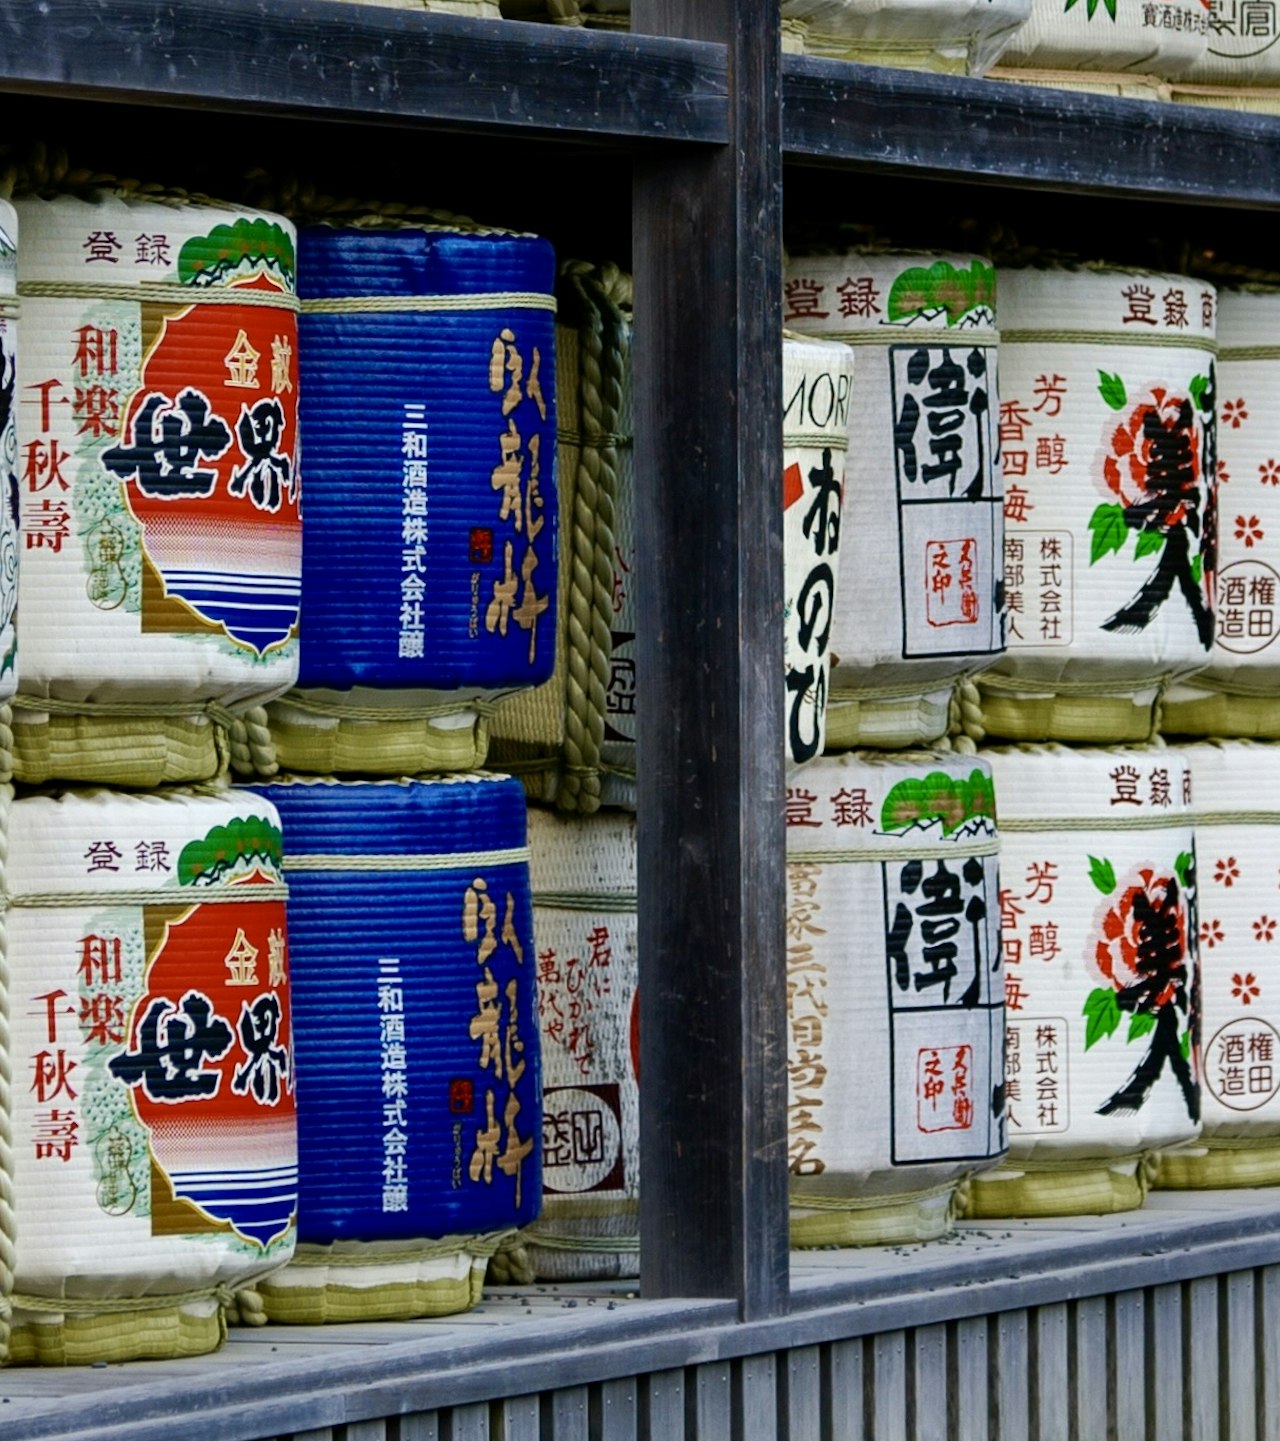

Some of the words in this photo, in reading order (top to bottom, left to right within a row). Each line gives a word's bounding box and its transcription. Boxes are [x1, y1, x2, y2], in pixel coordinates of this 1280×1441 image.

[82, 230, 171, 267] 登録
[784, 277, 881, 321] 登録
[70, 323, 119, 438] 和楽
[1033, 374, 1068, 476] 芳醇
[20, 377, 72, 554] 千秋壽
[1039, 537, 1063, 641] 株式会社
[84, 839, 172, 874] 登録
[784, 789, 876, 828] 登録
[1026, 862, 1064, 961] 芳醇
[76, 932, 124, 1047] 和楽
[28, 987, 80, 1163] 千秋壽
[1034, 1024, 1061, 1129] 株式会社
